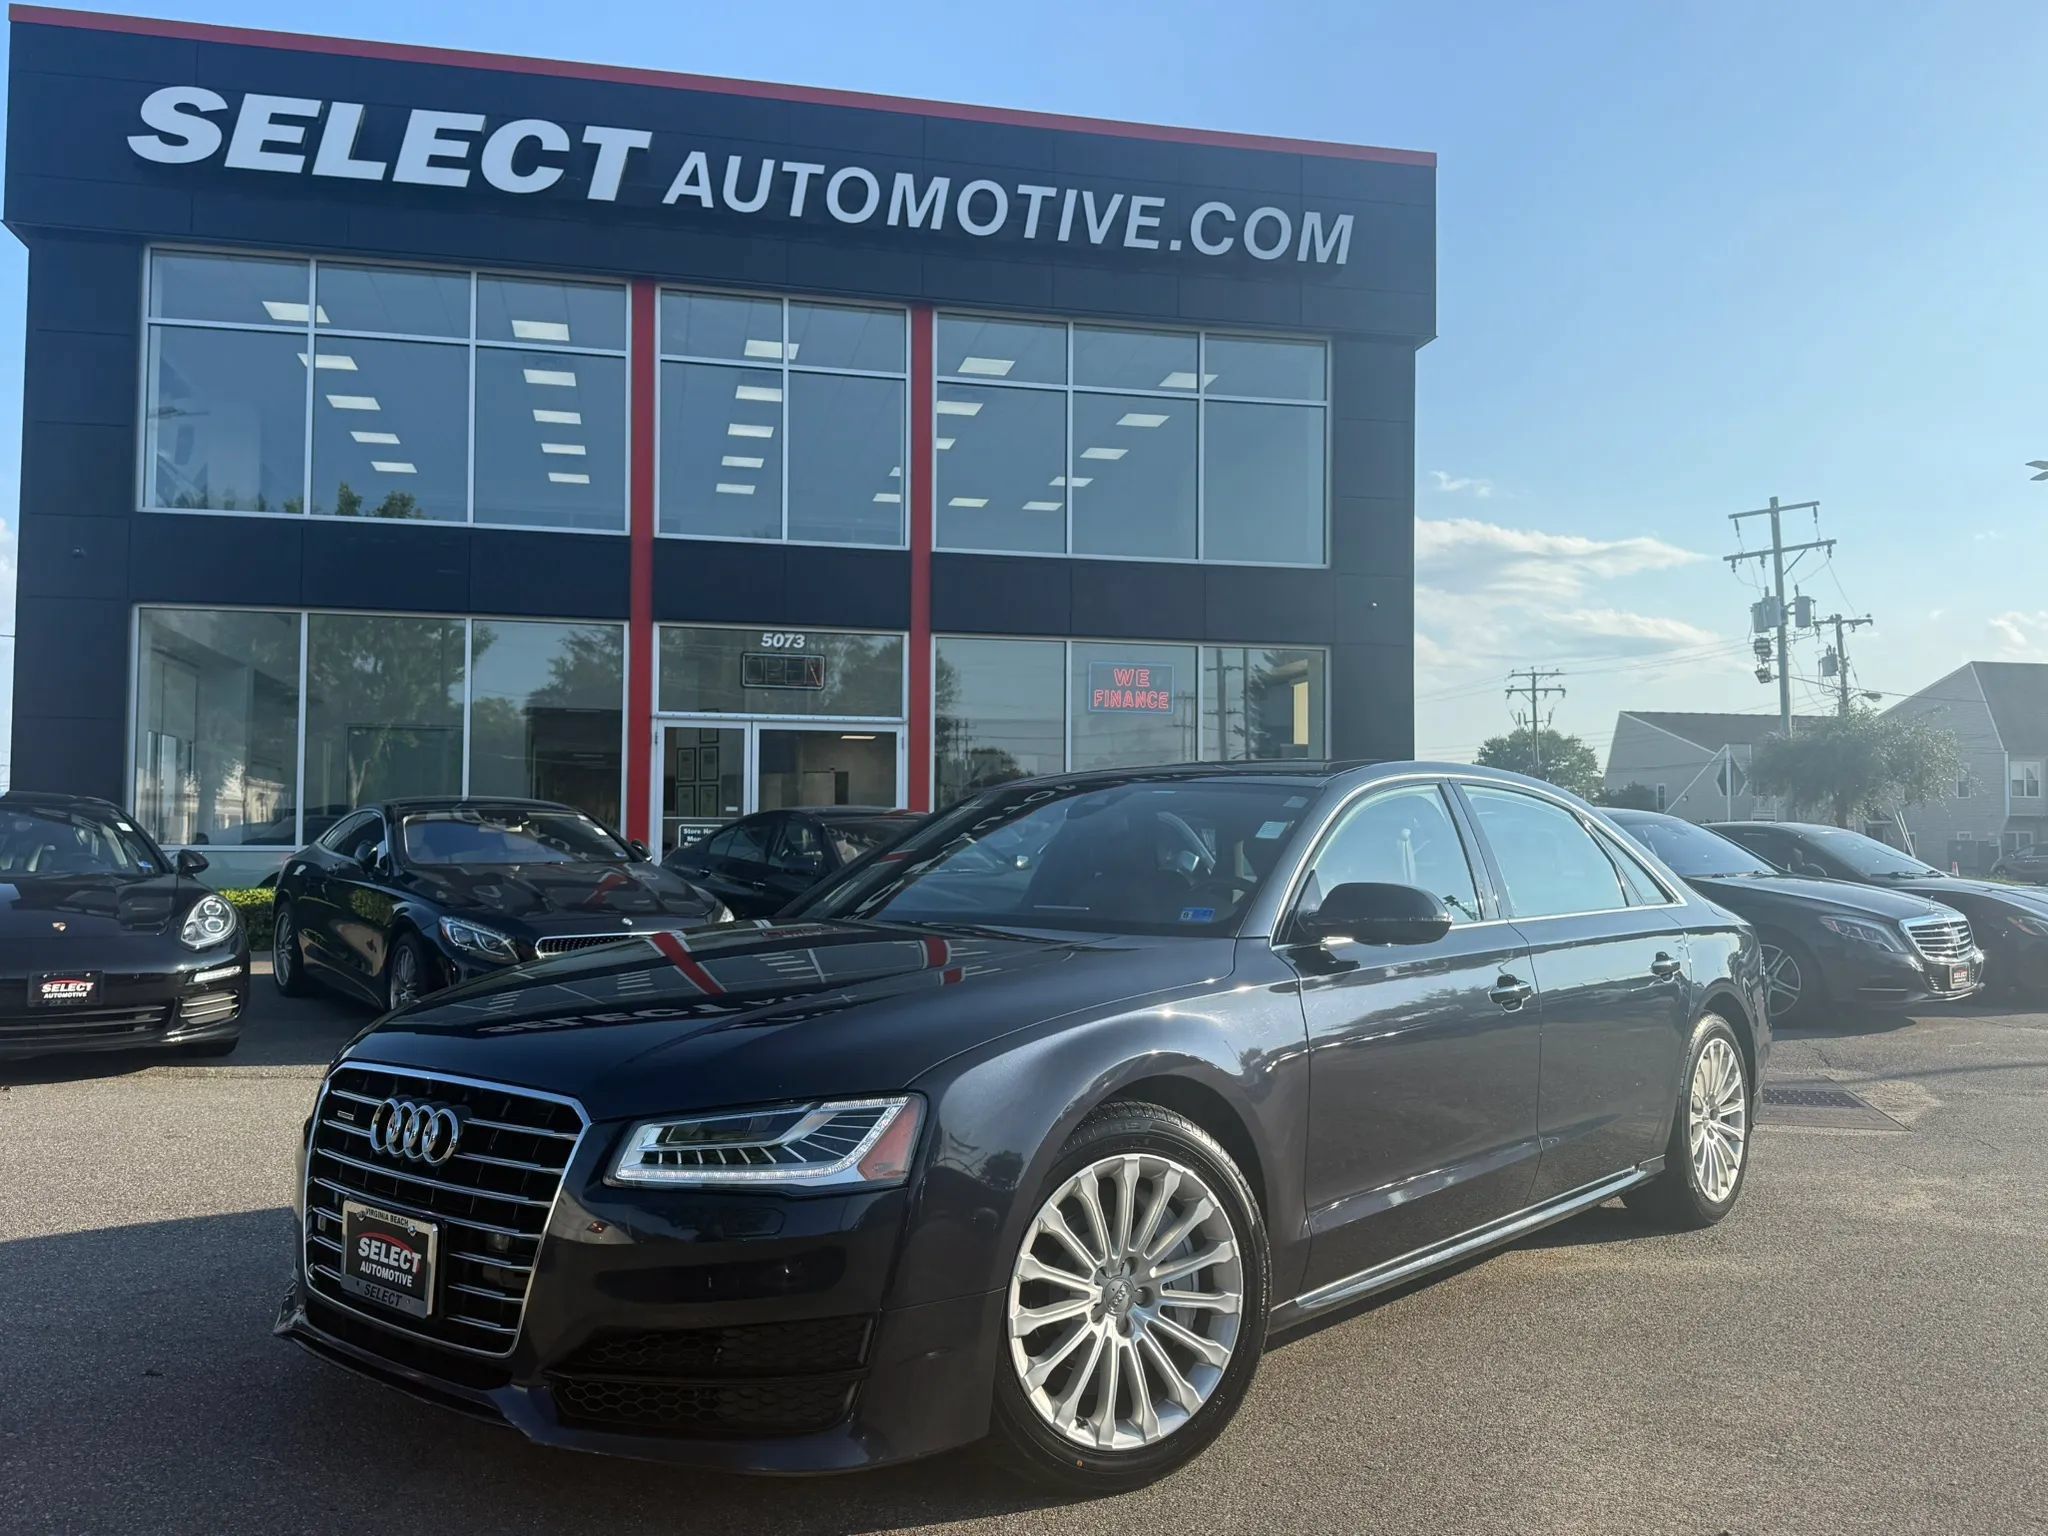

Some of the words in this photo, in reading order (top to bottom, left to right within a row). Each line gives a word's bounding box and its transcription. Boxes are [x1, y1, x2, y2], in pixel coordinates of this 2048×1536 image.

[126, 85, 652, 202] SELECT
[662, 151, 1354, 265] AUTOMOTIVE.COM
[761, 632, 805, 648] 5073
[1113, 668, 1151, 687] WE
[1093, 689, 1169, 709] FINANCE
[41, 982, 94, 992] SELECT
[366, 1208, 388, 1220] VIRGINIA
[390, 1215, 408, 1226] BEACH
[358, 1238, 422, 1273] SELECT
[360, 1261, 413, 1287] AUTOMOTIVE
[364, 1284, 402, 1307] SELECT
